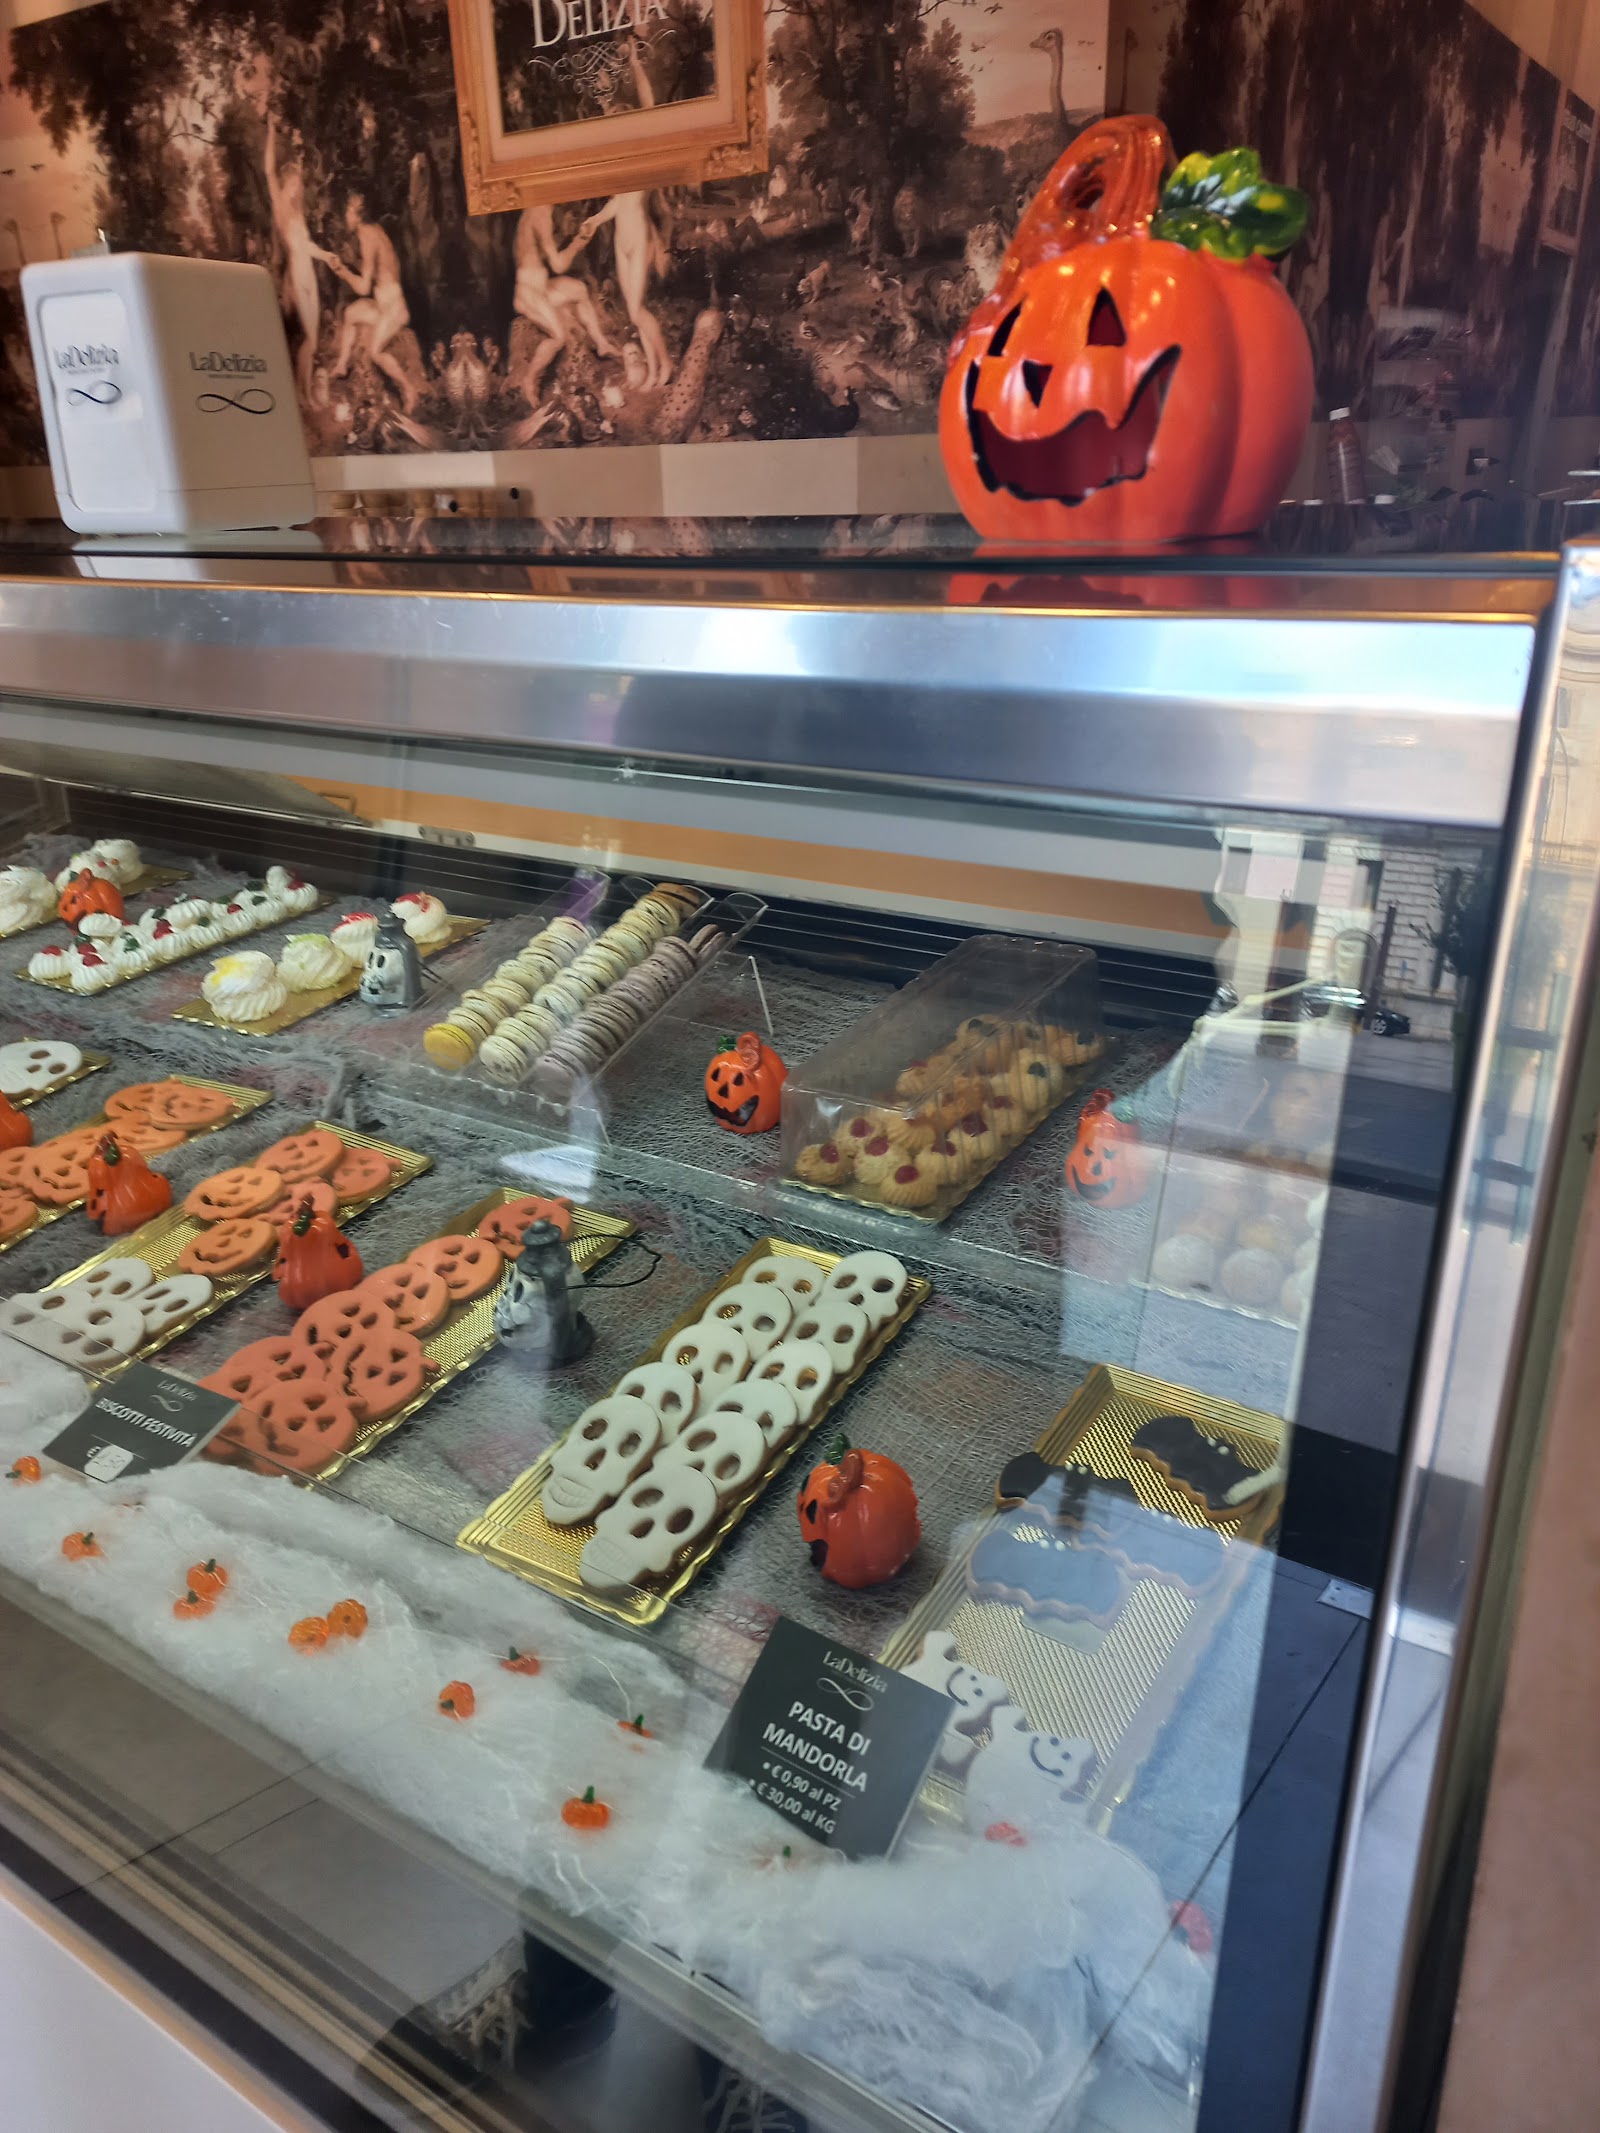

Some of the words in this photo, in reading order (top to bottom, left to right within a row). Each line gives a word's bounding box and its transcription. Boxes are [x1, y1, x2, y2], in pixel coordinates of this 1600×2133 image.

[189, 351, 267, 372] LaDelizia
[95, 1398, 147, 1425] BISCOTTI
[140, 1416, 198, 1447] FESTIVITÀ
[823, 1651, 888, 1693] LaDelizia
[788, 1701, 846, 1744] PASTA
[847, 1732, 872, 1756] DI
[762, 1722, 868, 1792] MANDORLA
[766, 1787, 802, 1814] 30,00
[801, 1809, 817, 1822] al
[815, 1814, 836, 1834] KG
[781, 1770, 810, 1793] 0,90
[808, 1788, 824, 1801] al
[822, 1793, 841, 1811] PZ
